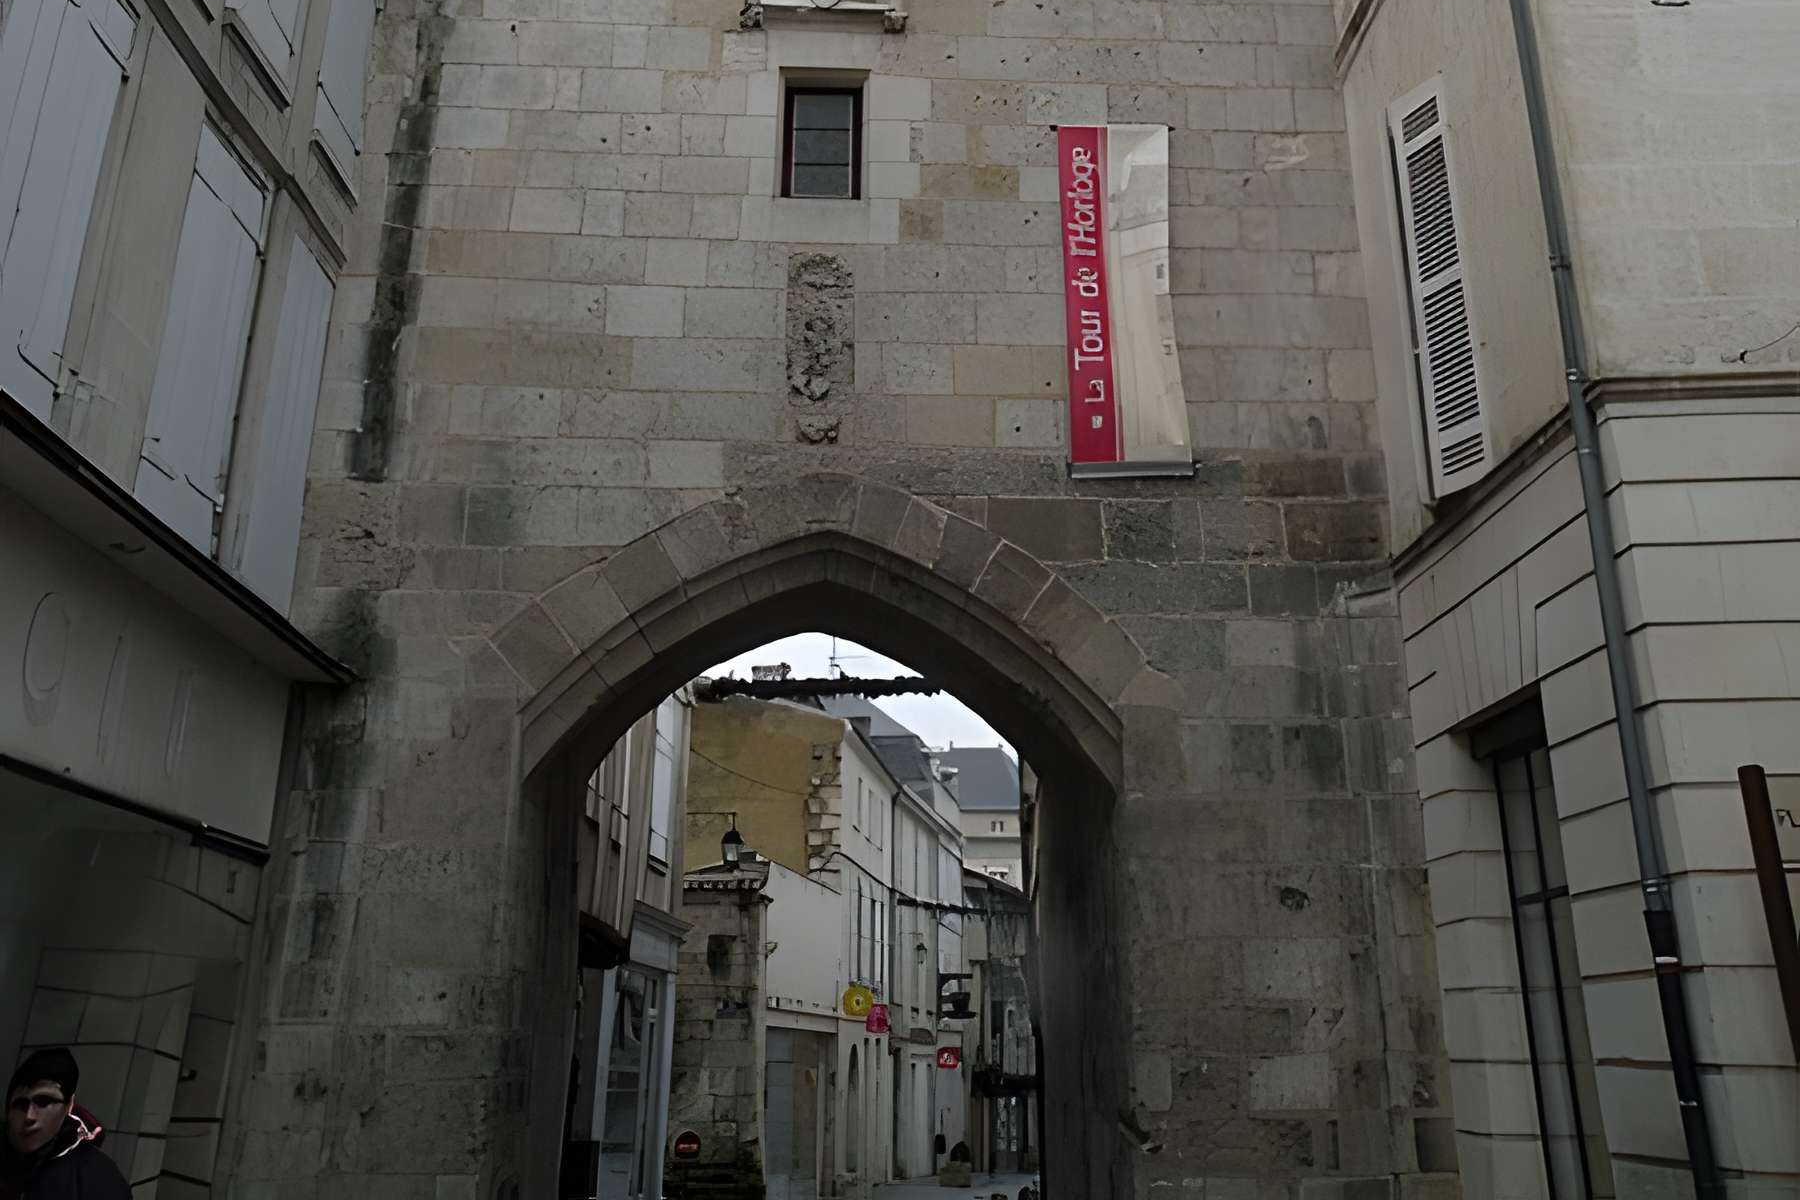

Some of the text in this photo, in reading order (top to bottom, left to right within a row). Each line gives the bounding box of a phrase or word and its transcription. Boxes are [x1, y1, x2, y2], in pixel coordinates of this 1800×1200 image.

[1072, 267, 1099, 297] de
[1075, 310, 1105, 371] Tour
[1085, 379, 1105, 403] La
